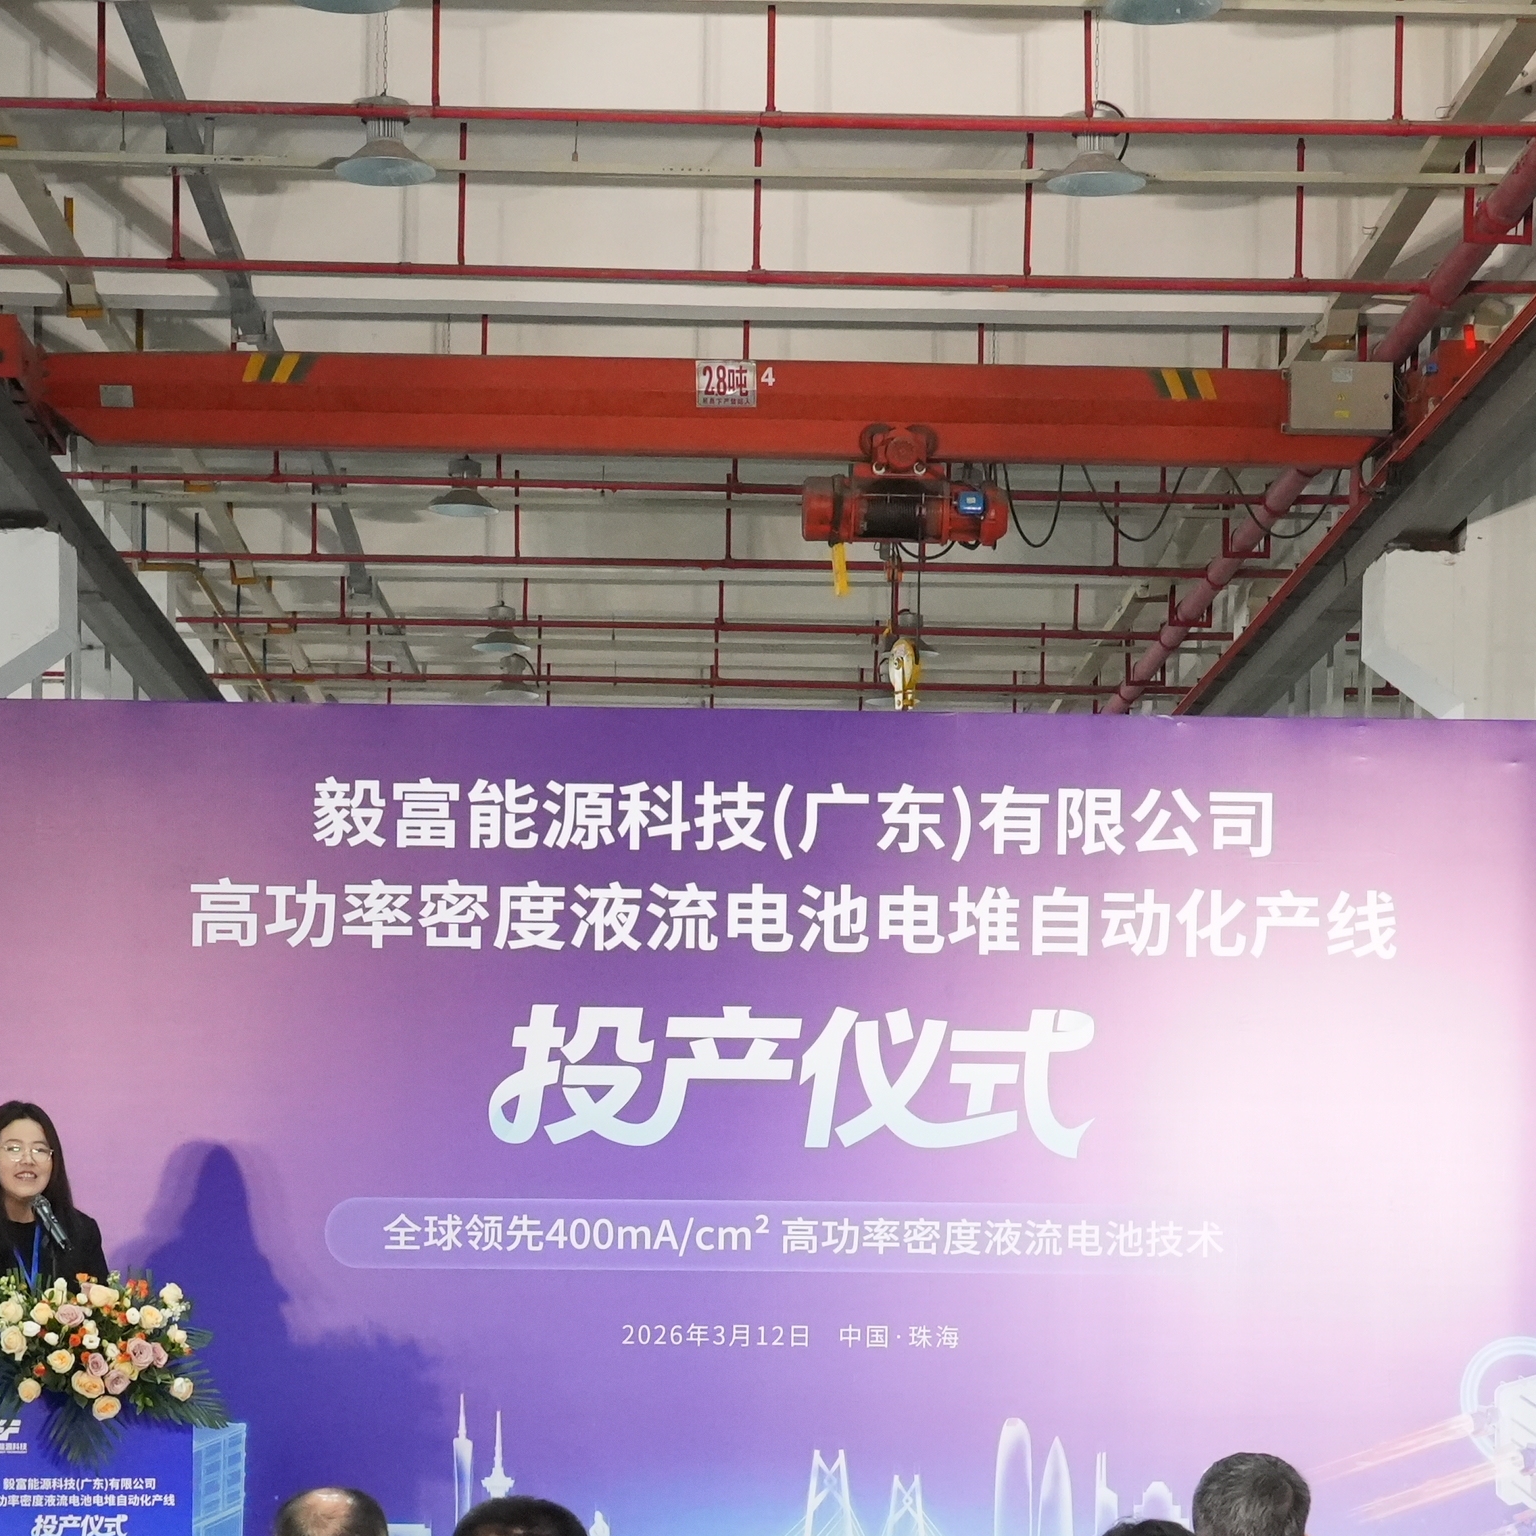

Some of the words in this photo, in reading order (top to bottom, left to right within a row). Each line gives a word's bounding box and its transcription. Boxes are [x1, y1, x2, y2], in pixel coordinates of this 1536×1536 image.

[702, 365, 749, 397] 2.8吨
[761, 366, 776, 387] 4
[313, 776, 1276, 859] 毅富能源科技(广东)有限公司
[190, 878, 1399, 961] 高功率密度液流电池电堆自动化产线
[488, 1003, 1096, 1159] 投产仪式
[780, 1213, 1225, 1262] 高功率密度液流电池技术
[621, 1322, 812, 1349] 2026年3月12日
[838, 1322, 960, 1350] 中国·珠海
[2, 1477, 156, 1492] 毅富能源科技(广东)有限公司
